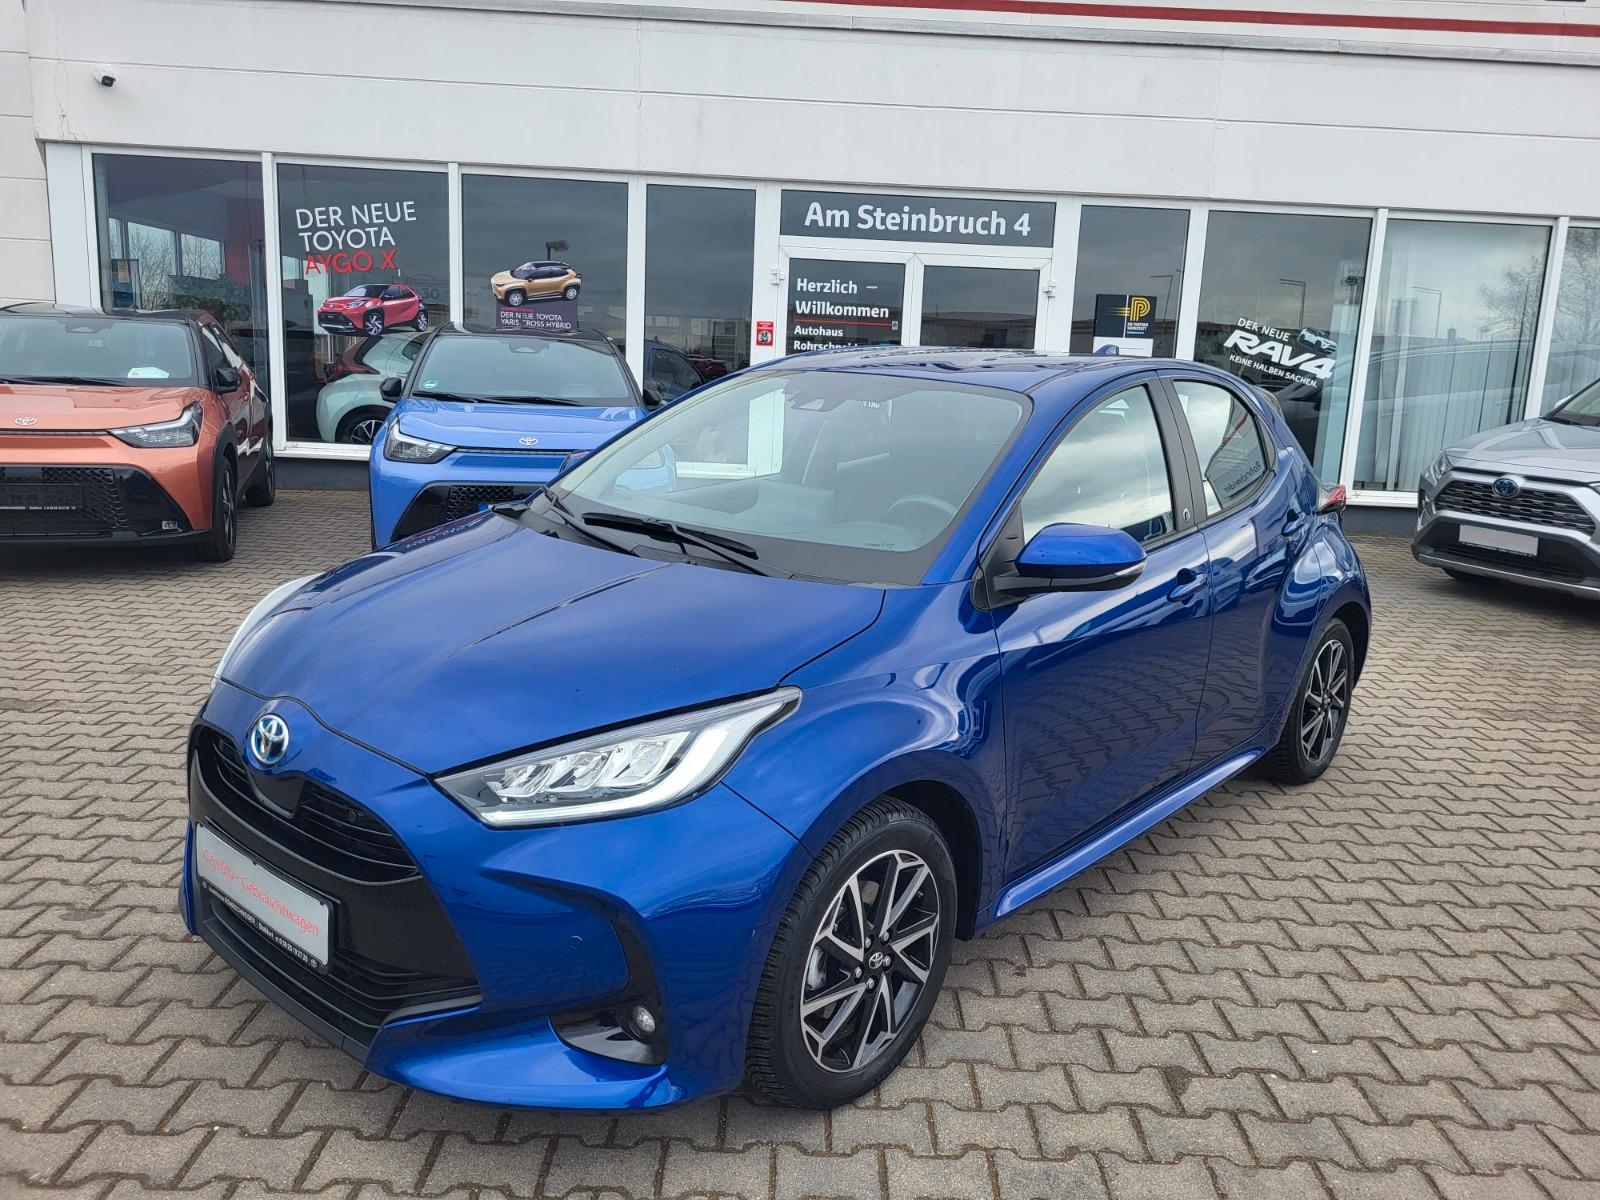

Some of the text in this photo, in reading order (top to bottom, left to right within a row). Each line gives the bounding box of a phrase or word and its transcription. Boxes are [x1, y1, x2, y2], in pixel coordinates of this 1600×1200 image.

[296, 201, 417, 229] DER NEUE
[804, 202, 1031, 237] Am Steinbruch 4
[299, 227, 396, 252] TOYOTA
[305, 250, 399, 275] AYGO X
[796, 278, 858, 294] Herzlich
[500, 311, 563, 321] DER NEUE TOYOTA
[795, 301, 889, 318] Willkommen
[501, 318, 520, 326] YARIS
[546, 321, 572, 329] HYBRID
[794, 325, 844, 336] Autohaus
[1237, 317, 1291, 342] DER NEUE
[1223, 329, 1337, 380] RAV4
[1229, 354, 1319, 388] KEINE HALBEN SACHEN.
